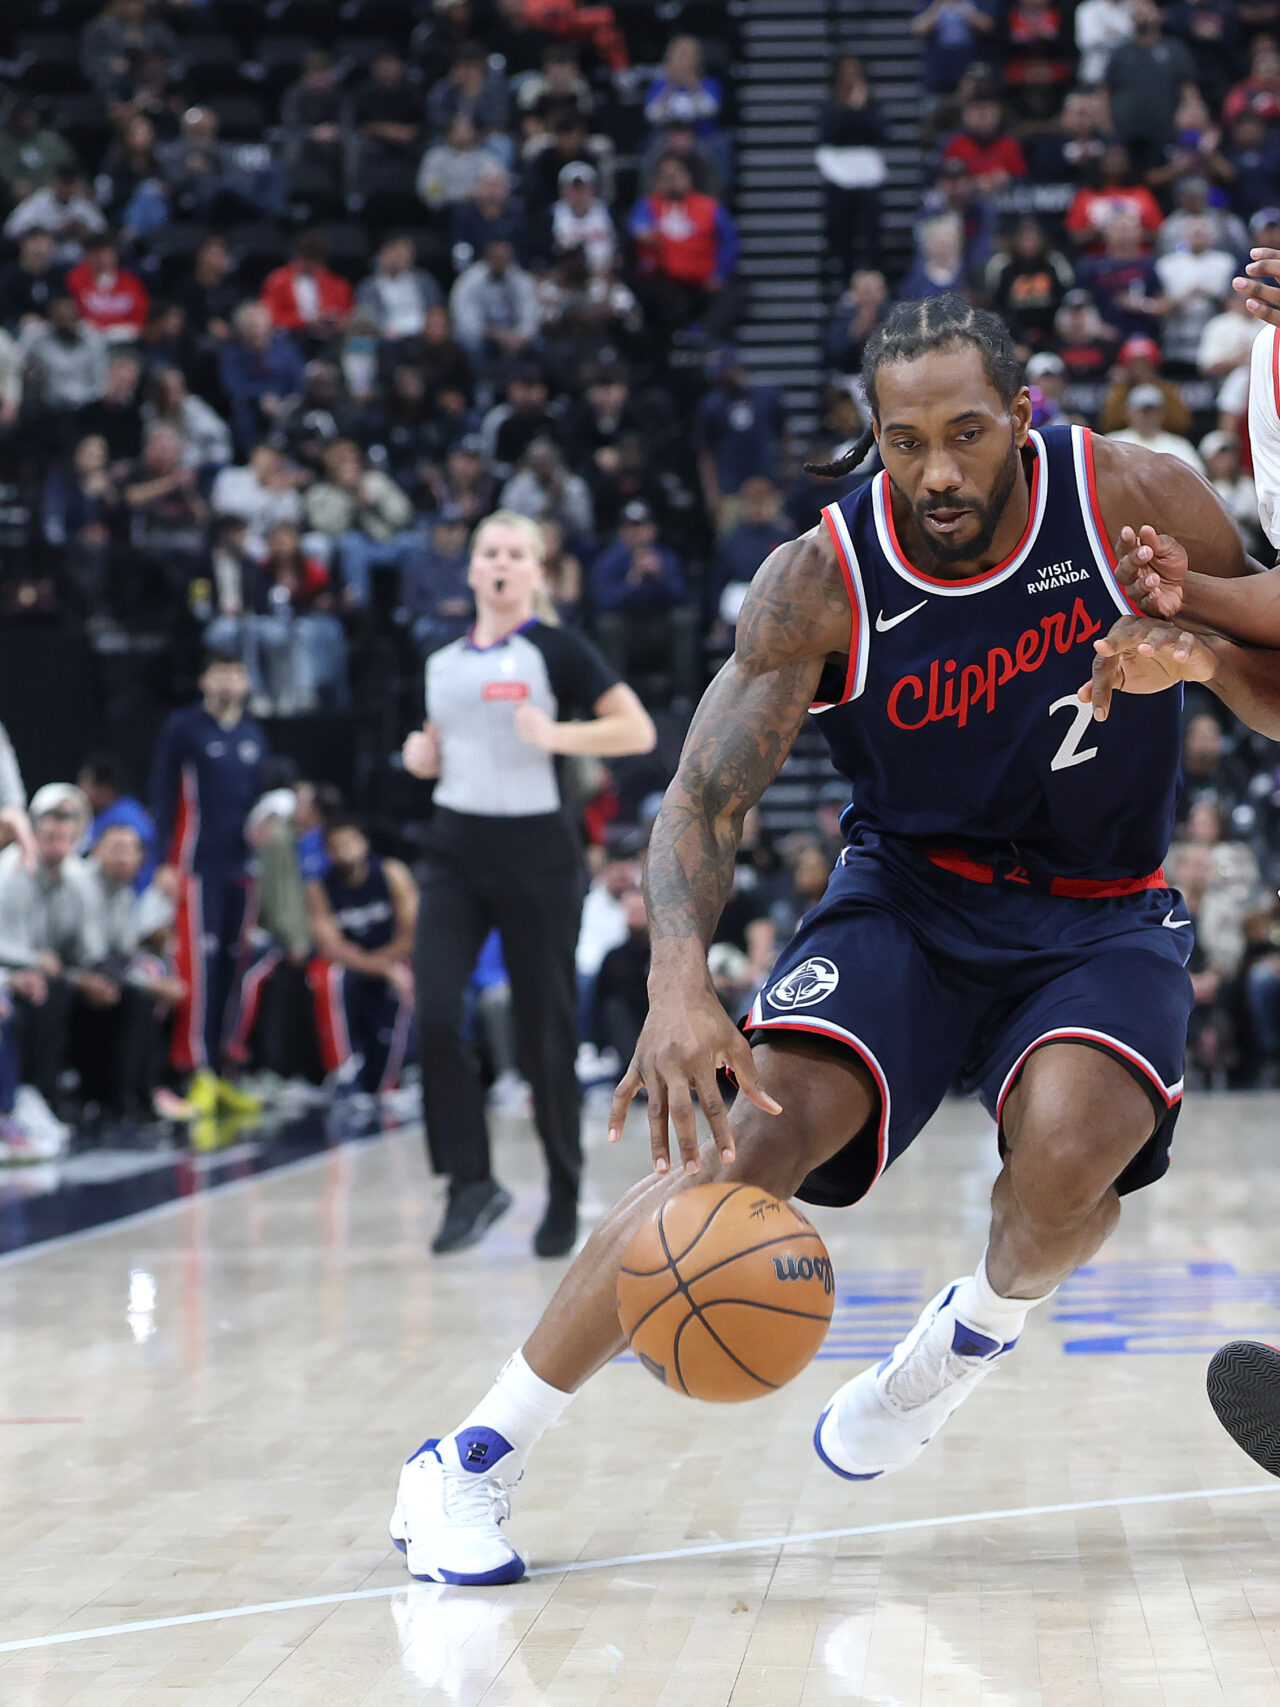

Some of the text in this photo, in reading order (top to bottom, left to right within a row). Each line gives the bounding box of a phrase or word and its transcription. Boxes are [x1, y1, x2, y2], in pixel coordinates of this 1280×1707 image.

[1027, 568, 1091, 594] RWANDA
[1037, 560, 1072, 579] VISIT
[887, 596, 1102, 730] Clippers
[1048, 693, 1099, 772] 2
[771, 1255, 835, 1296] lson
